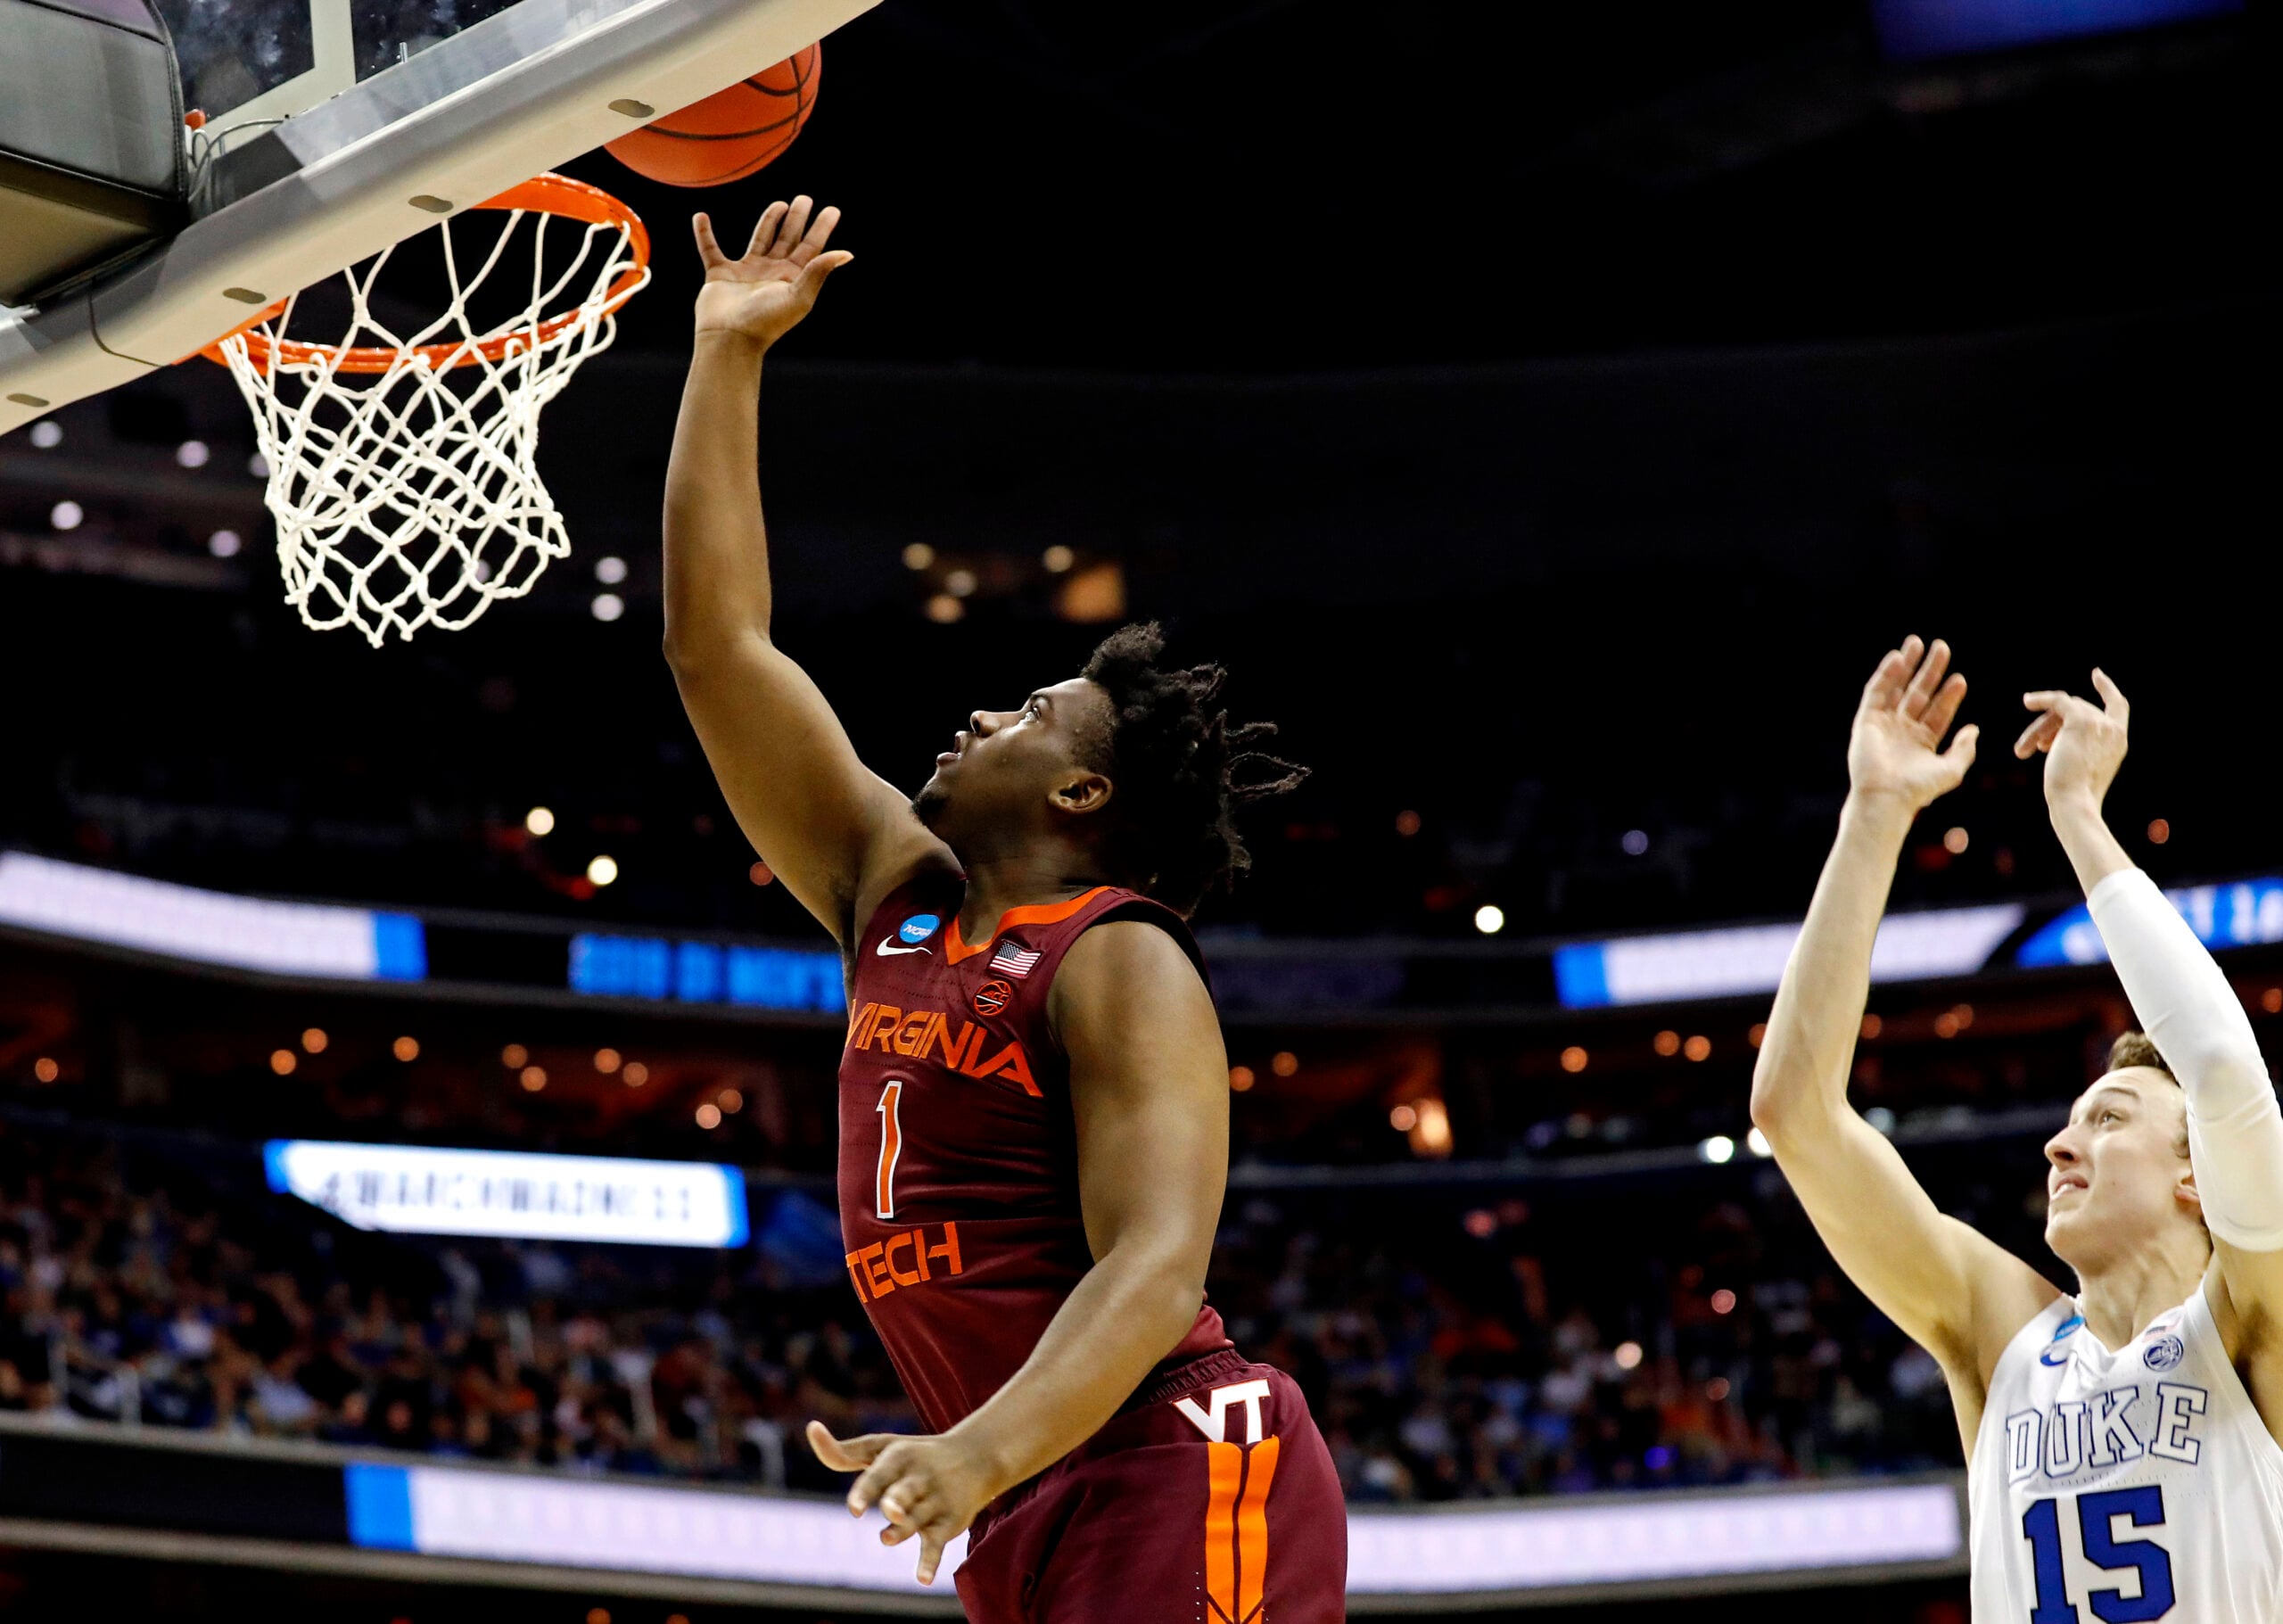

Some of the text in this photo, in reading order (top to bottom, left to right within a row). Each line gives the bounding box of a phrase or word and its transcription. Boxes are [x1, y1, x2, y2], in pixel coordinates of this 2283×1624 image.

[981, 990, 1010, 1002] ACC
[845, 999, 1044, 1098] VIRGINIA
[875, 1080, 904, 1219] 1
[845, 1221, 962, 1304] TECH
[1171, 1377, 1271, 1445] VT
[2006, 1382, 2208, 1486] DUKE
[2023, 1486, 2177, 1624] 15
